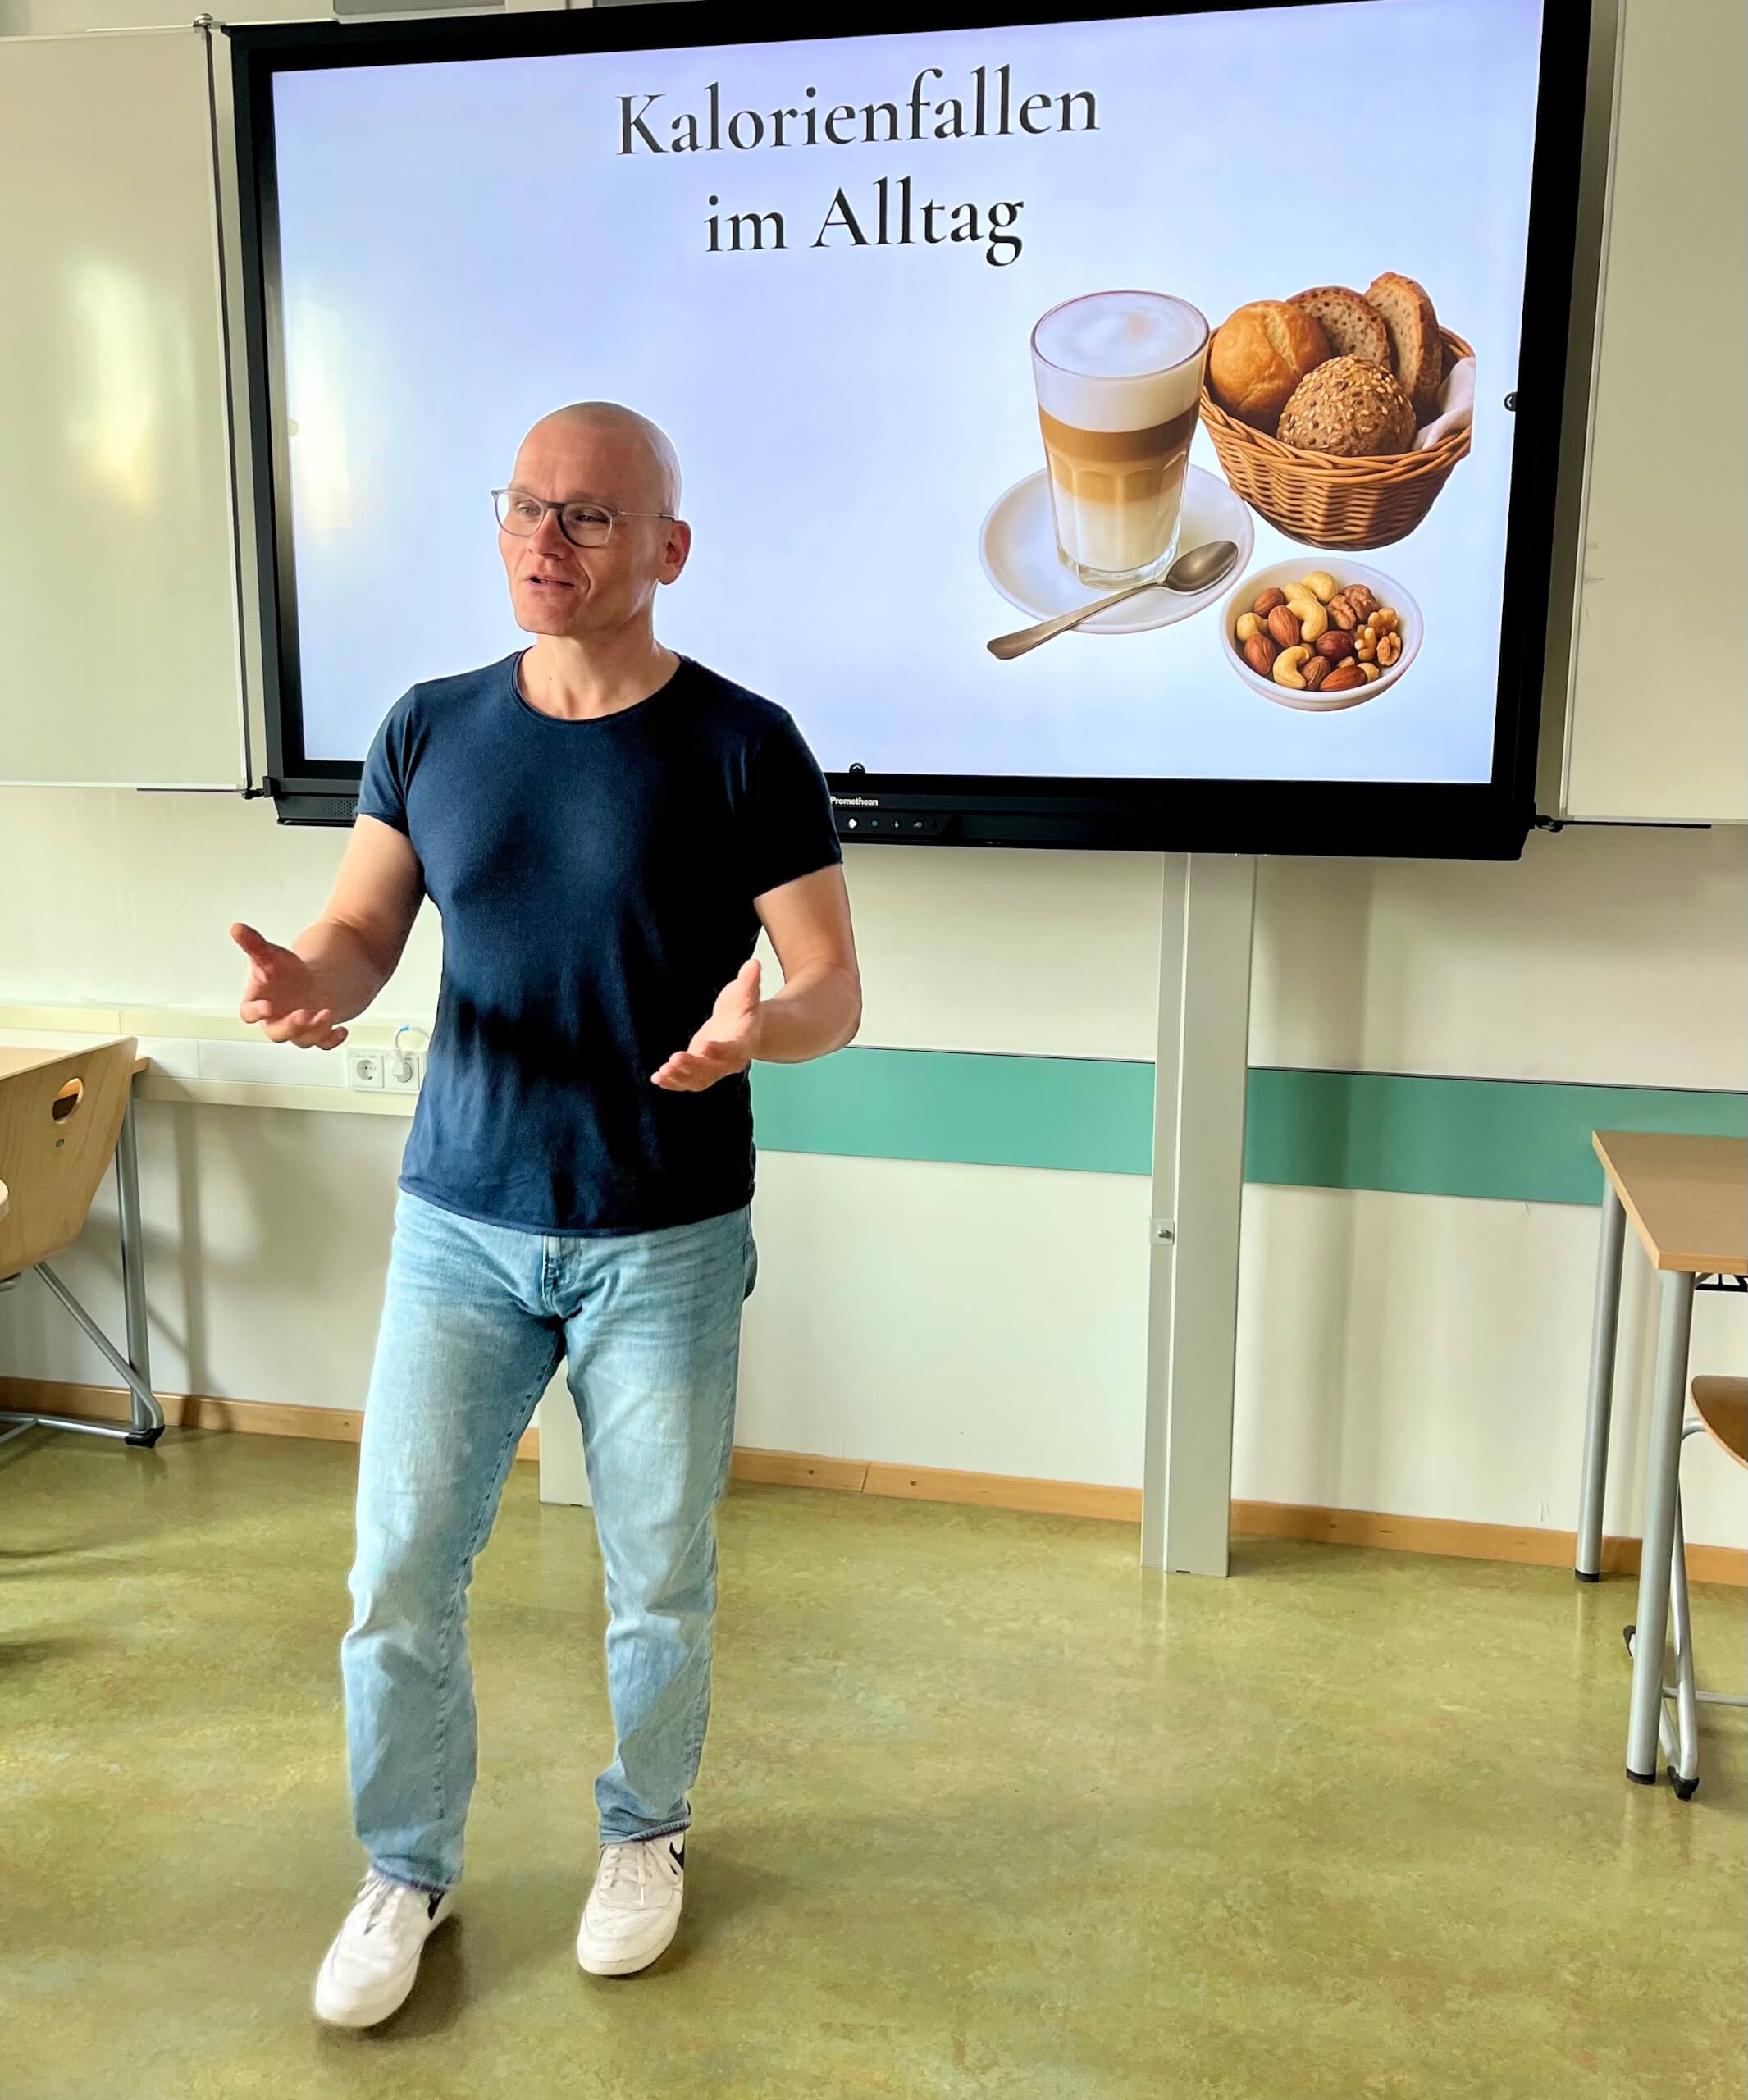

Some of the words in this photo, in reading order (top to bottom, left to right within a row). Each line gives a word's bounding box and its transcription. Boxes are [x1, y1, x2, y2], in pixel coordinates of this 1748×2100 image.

[617, 64, 1099, 155] Kalorienfallen
[705, 194, 787, 252] im
[810, 176, 1025, 267] Alltag
[829, 796, 879, 806] Promethean
